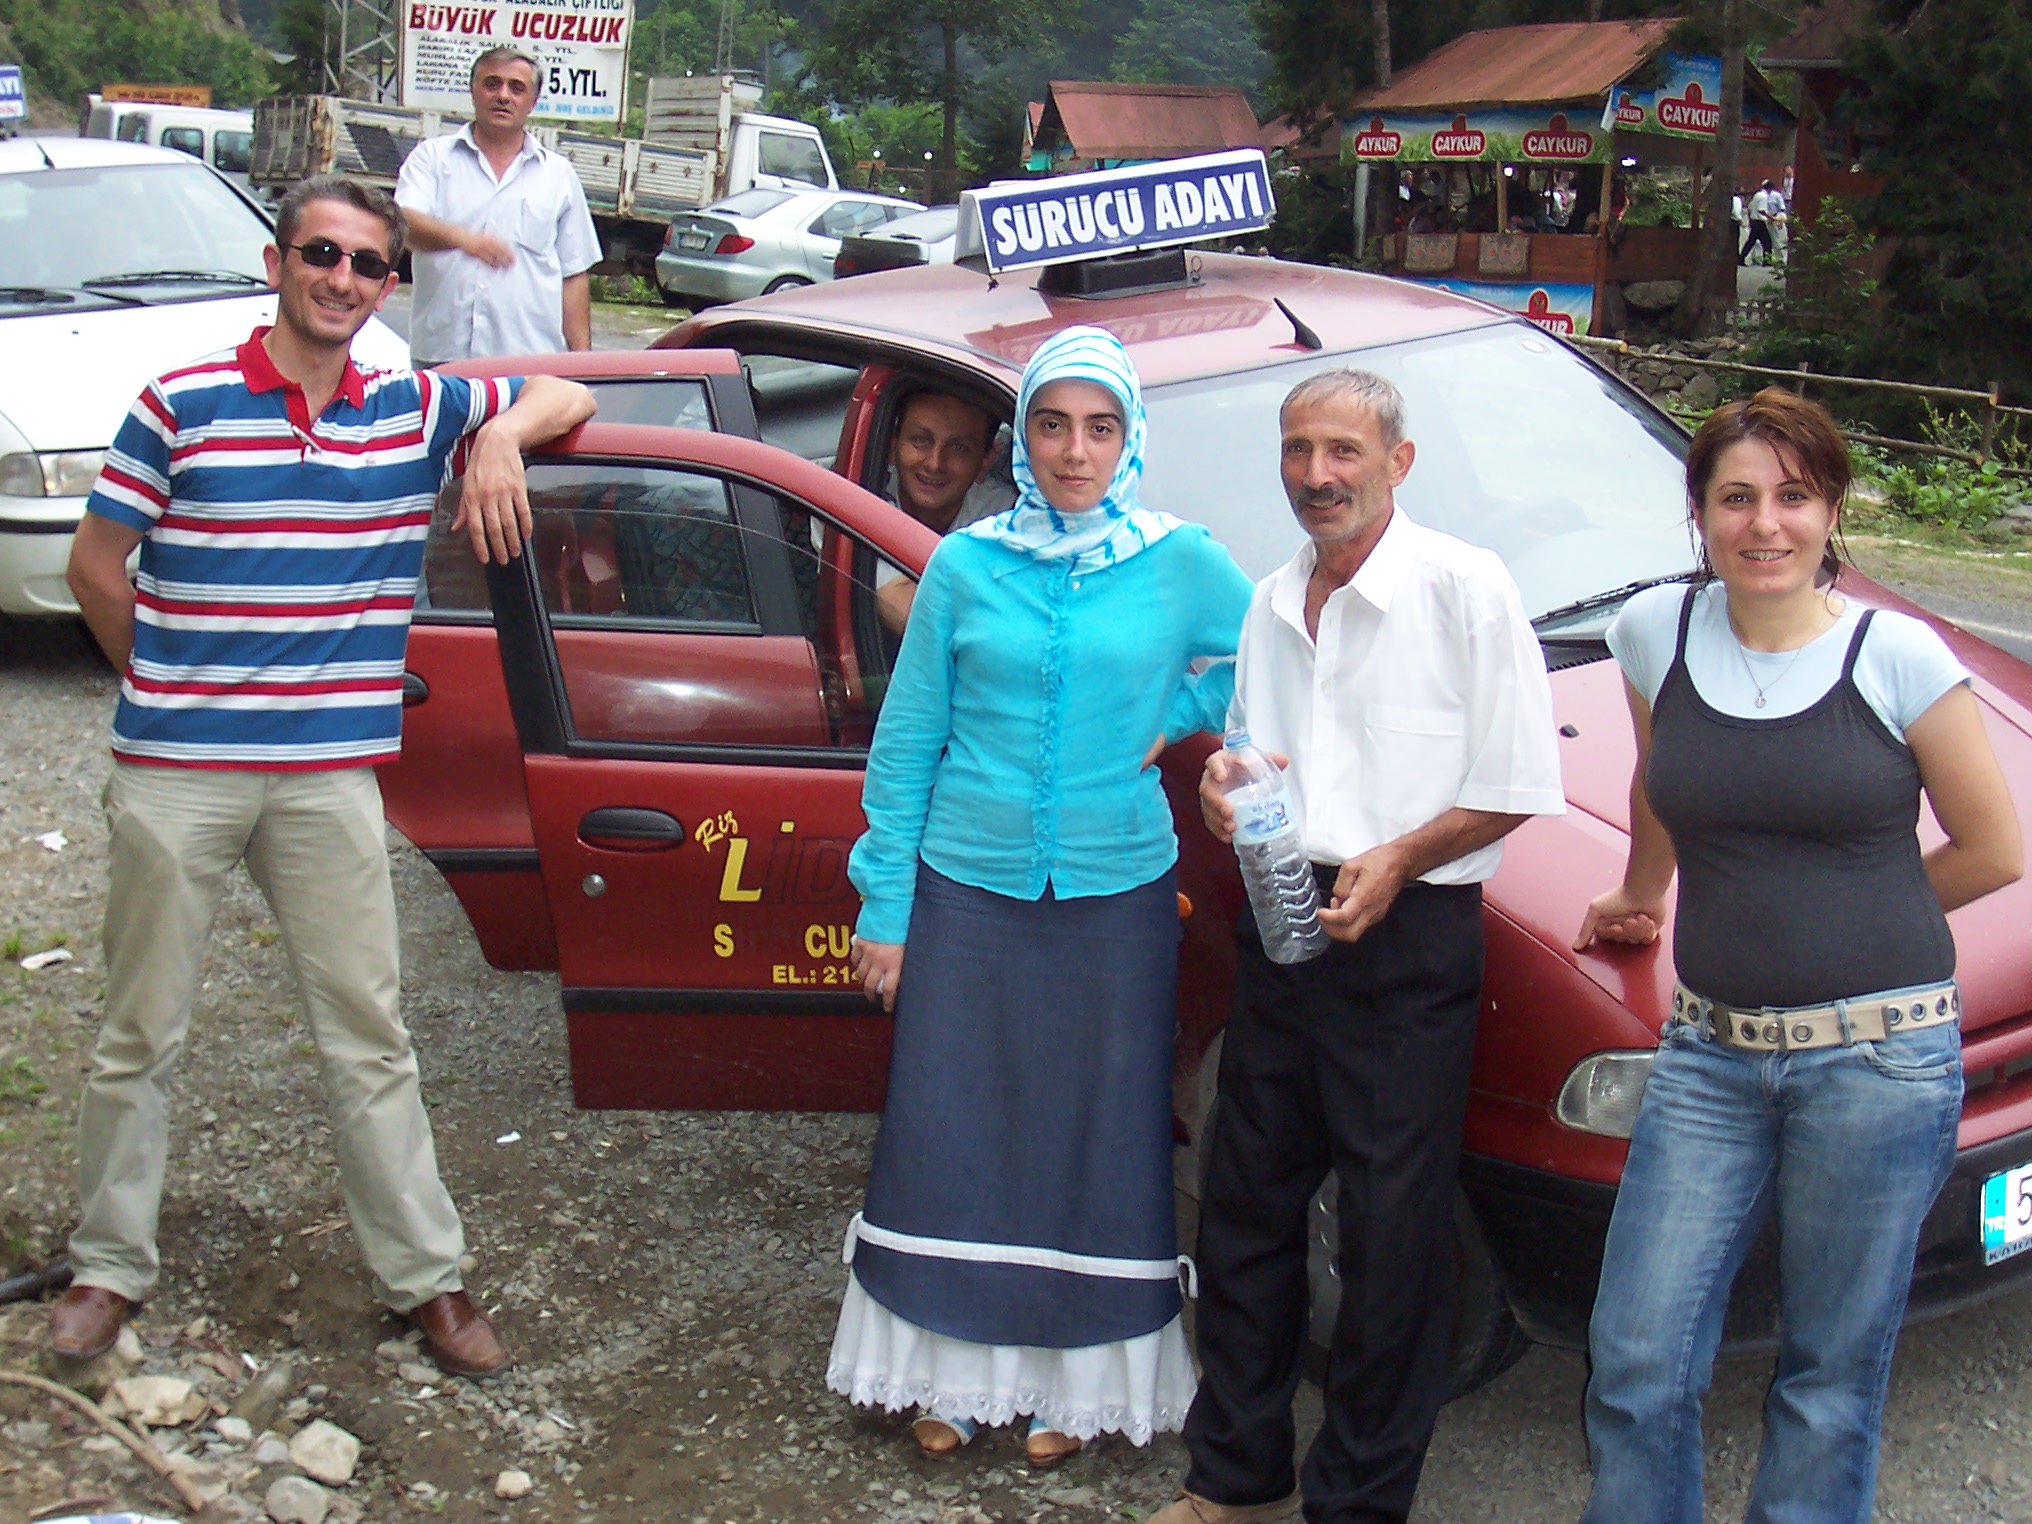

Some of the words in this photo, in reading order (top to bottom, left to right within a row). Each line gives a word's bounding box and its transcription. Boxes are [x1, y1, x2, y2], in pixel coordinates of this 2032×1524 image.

[409, 3, 497, 35] BÜYÜK
[511, 10, 626, 43] UCUZLUK
[548, 67, 607, 98] 5.YTL.
[1155, 171, 1264, 232] ADAYI
